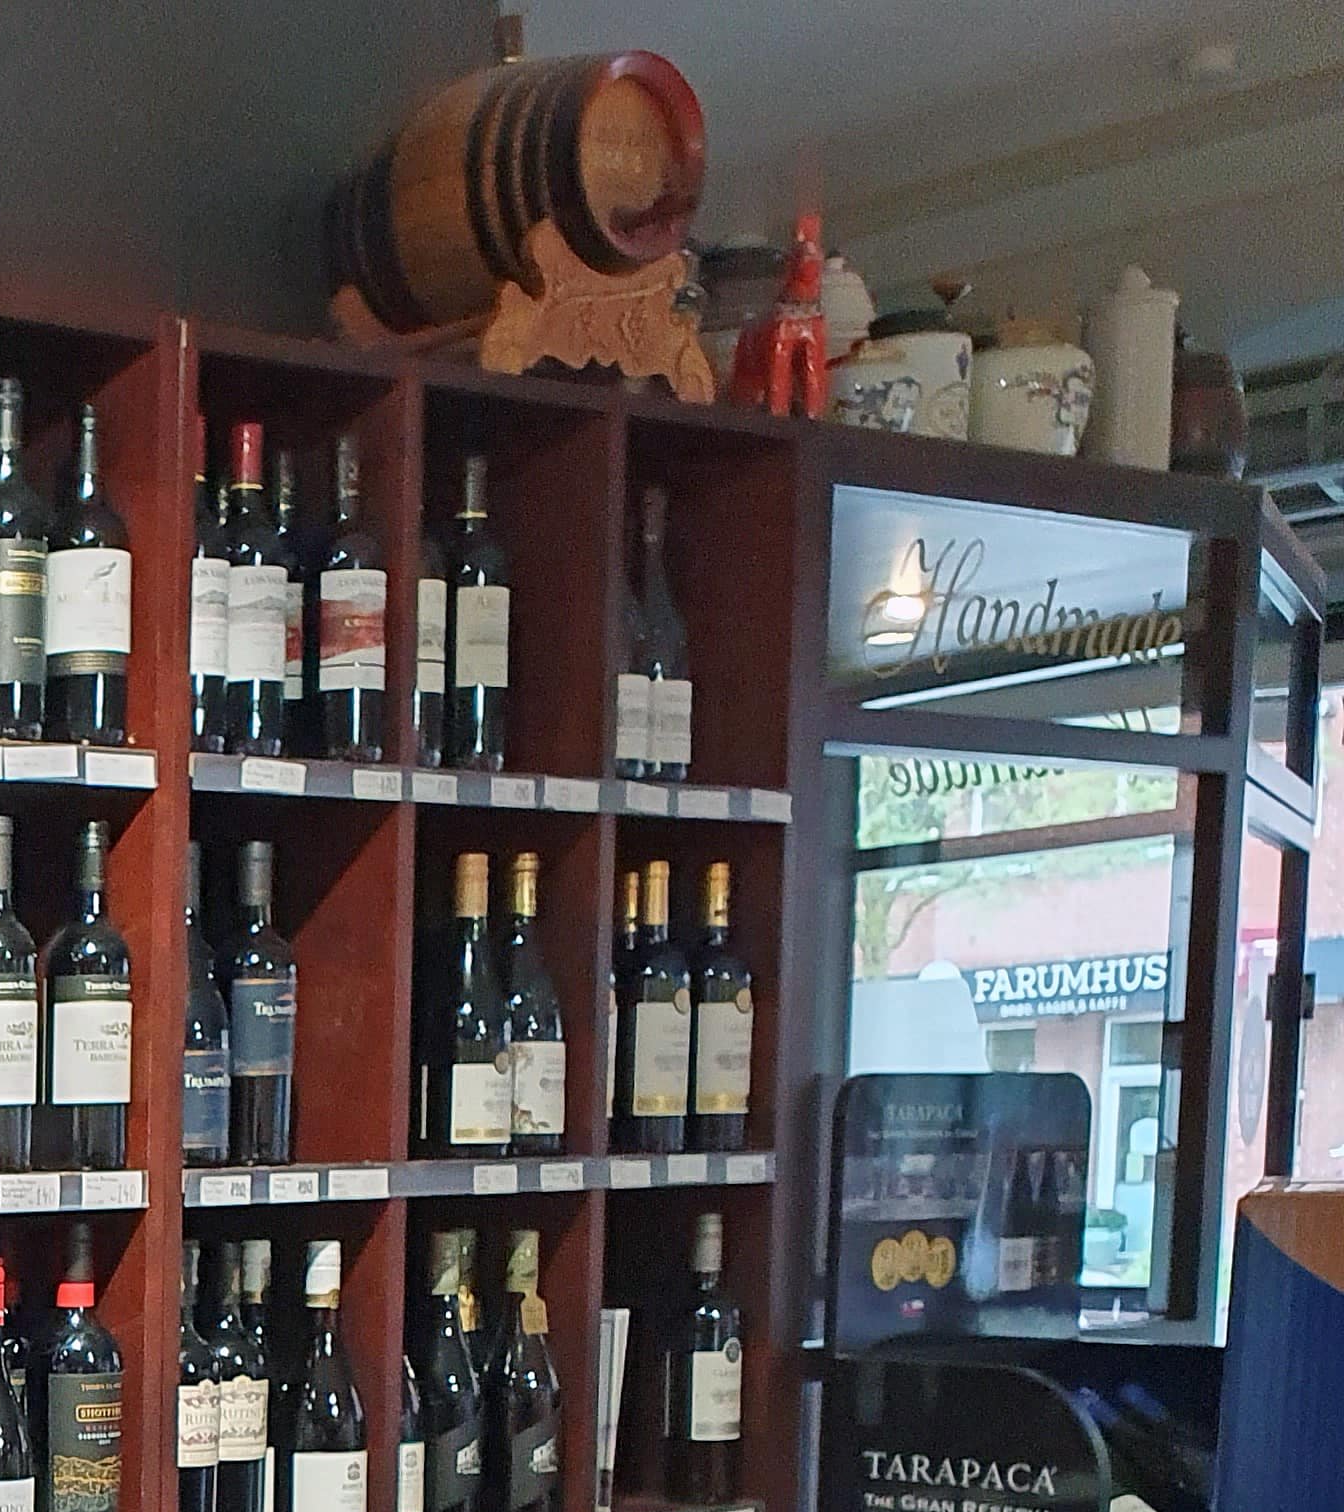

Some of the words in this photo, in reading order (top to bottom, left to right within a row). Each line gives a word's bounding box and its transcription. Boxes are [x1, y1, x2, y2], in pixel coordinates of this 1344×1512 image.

[863, 537, 1184, 677] Handmade
[974, 955, 1168, 1003] FARUMHUS
[863, 1450, 1058, 1497] TARAPACÁ
[864, 1492, 895, 1510] THE
